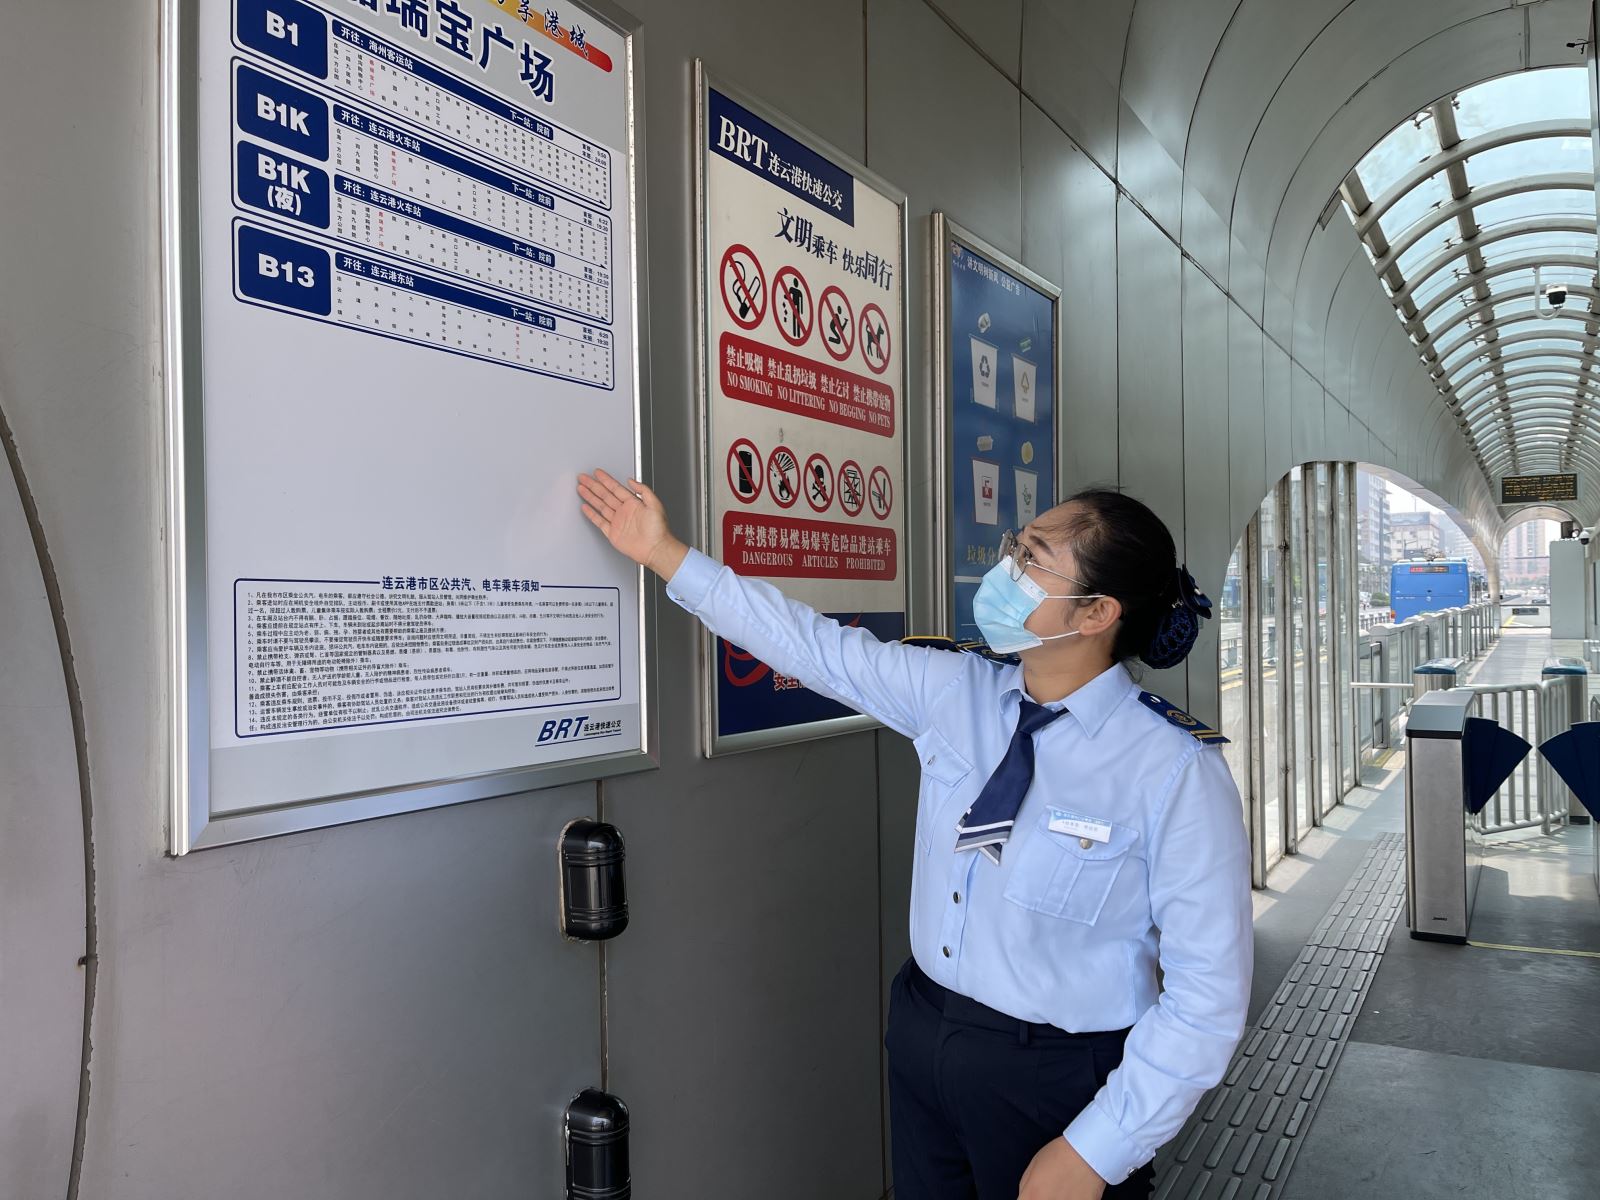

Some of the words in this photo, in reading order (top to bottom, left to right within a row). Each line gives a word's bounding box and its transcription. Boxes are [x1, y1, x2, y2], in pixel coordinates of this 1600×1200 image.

[266, 10, 299, 48] B1
[349, 0, 554, 103] 瑞宝广场
[256, 93, 311, 136] B1K
[341, 110, 420, 152] 开往：连云港火车站
[717, 116, 769, 169] BRT
[257, 151, 311, 195] B1K
[768, 151, 843, 211] 连云港快速公交
[343, 180, 422, 217] 开往：连云港火车站
[258, 253, 315, 288] B13
[775, 208, 838, 265] 文明乘车
[842, 247, 893, 291] 快乐同行
[343, 257, 414, 287] 开往：连云港东站
[726, 345, 764, 376] 禁止吸烟
[768, 358, 817, 391] 禁止乱扔垃圾
[820, 373, 850, 400] 禁止乞讨
[727, 371, 738, 387] NO
[739, 374, 773, 397] SMOKING
[777, 385, 788, 400] NO
[789, 389, 825, 411] LITTERING
[829, 399, 838, 413] NO
[839, 401, 866, 422] BEGGING
[869, 410, 878, 423] NO
[879, 412, 891, 428] PETS
[732, 524, 892, 556] 严禁携带易燃易爆等危险品进站乘车
[742, 551, 793, 567] DANGEROUS
[802, 555, 838, 569] ARTICLES
[846, 557, 885, 571] PROHIBITED
[382, 576, 540, 592] 连云港市区公共汽、电车乘车须知
[537, 716, 589, 742] BRT
